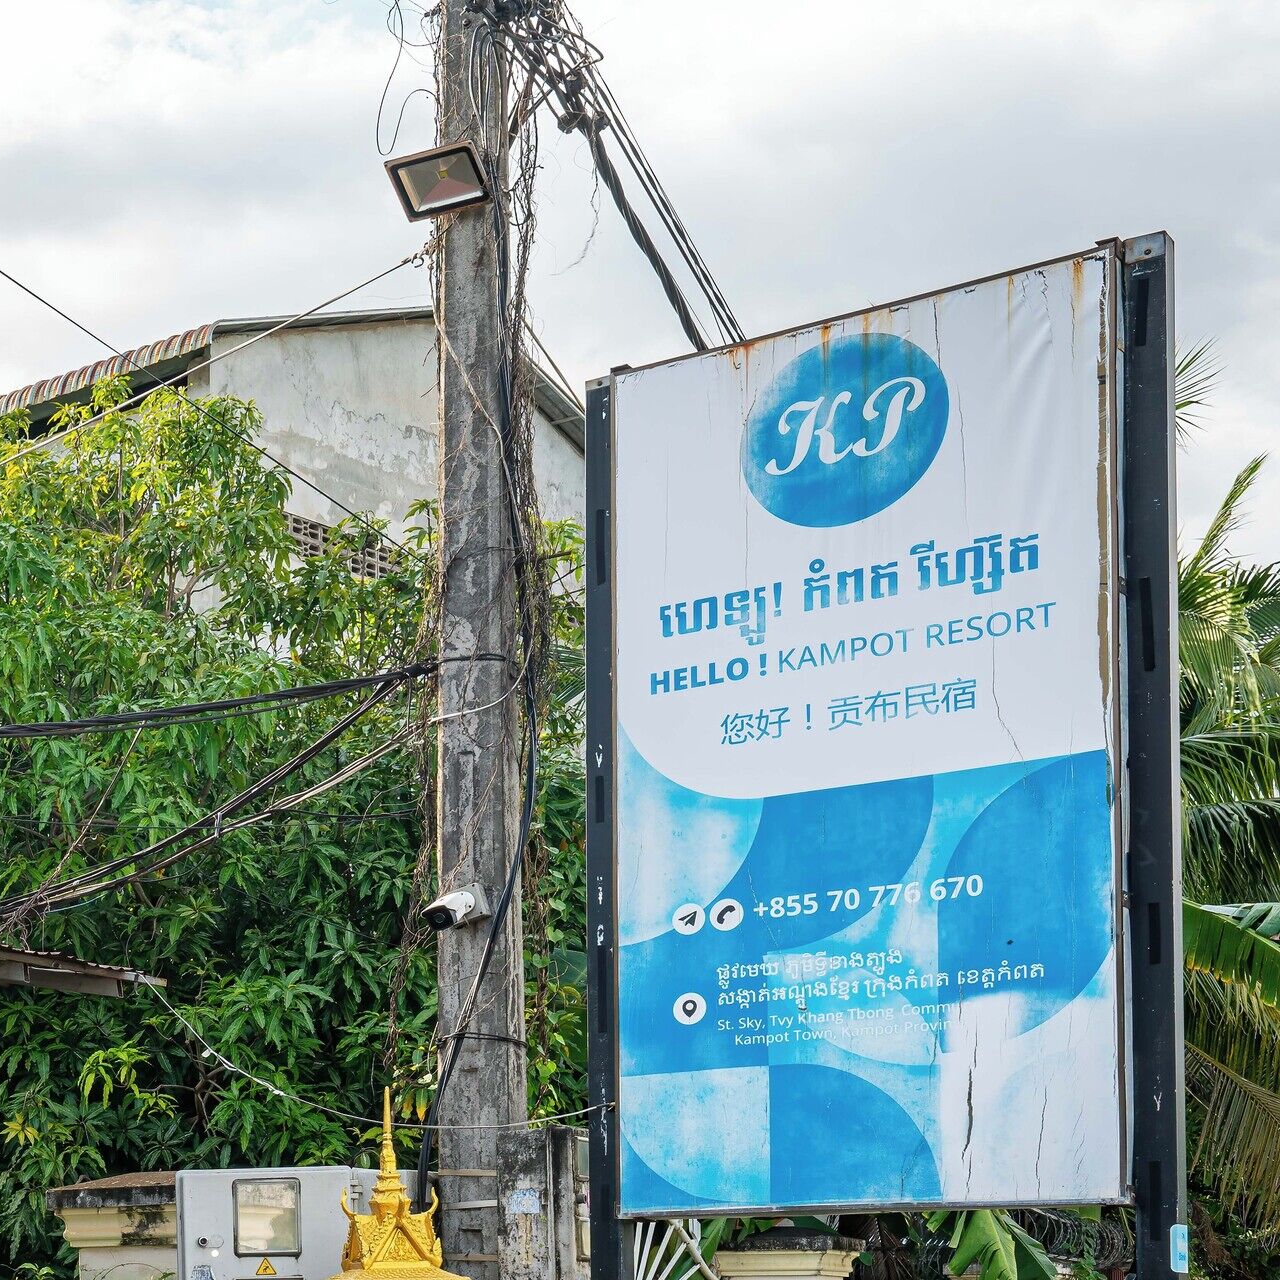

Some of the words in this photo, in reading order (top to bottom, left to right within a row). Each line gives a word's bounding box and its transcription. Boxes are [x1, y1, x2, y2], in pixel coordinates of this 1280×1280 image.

[763, 376, 927, 478] KP
[803, 558, 898, 611] កំពត
[778, 627, 914, 673] KAMPOT
[926, 601, 1057, 649] RESORT
[753, 893, 819, 919] +855
[827, 888, 861, 912] 70
[868, 882, 922, 908] 776
[929, 874, 985, 901] 670
[717, 1018, 734, 1031] St.
[738, 1016, 766, 1031] Sky,
[770, 1014, 794, 1029] Tvy
[797, 1009, 845, 1025] Khang
[847, 1006, 895, 1023] Tbong
[735, 1030, 790, 1046] Kampot
[794, 1027, 837, 1041] Town,
